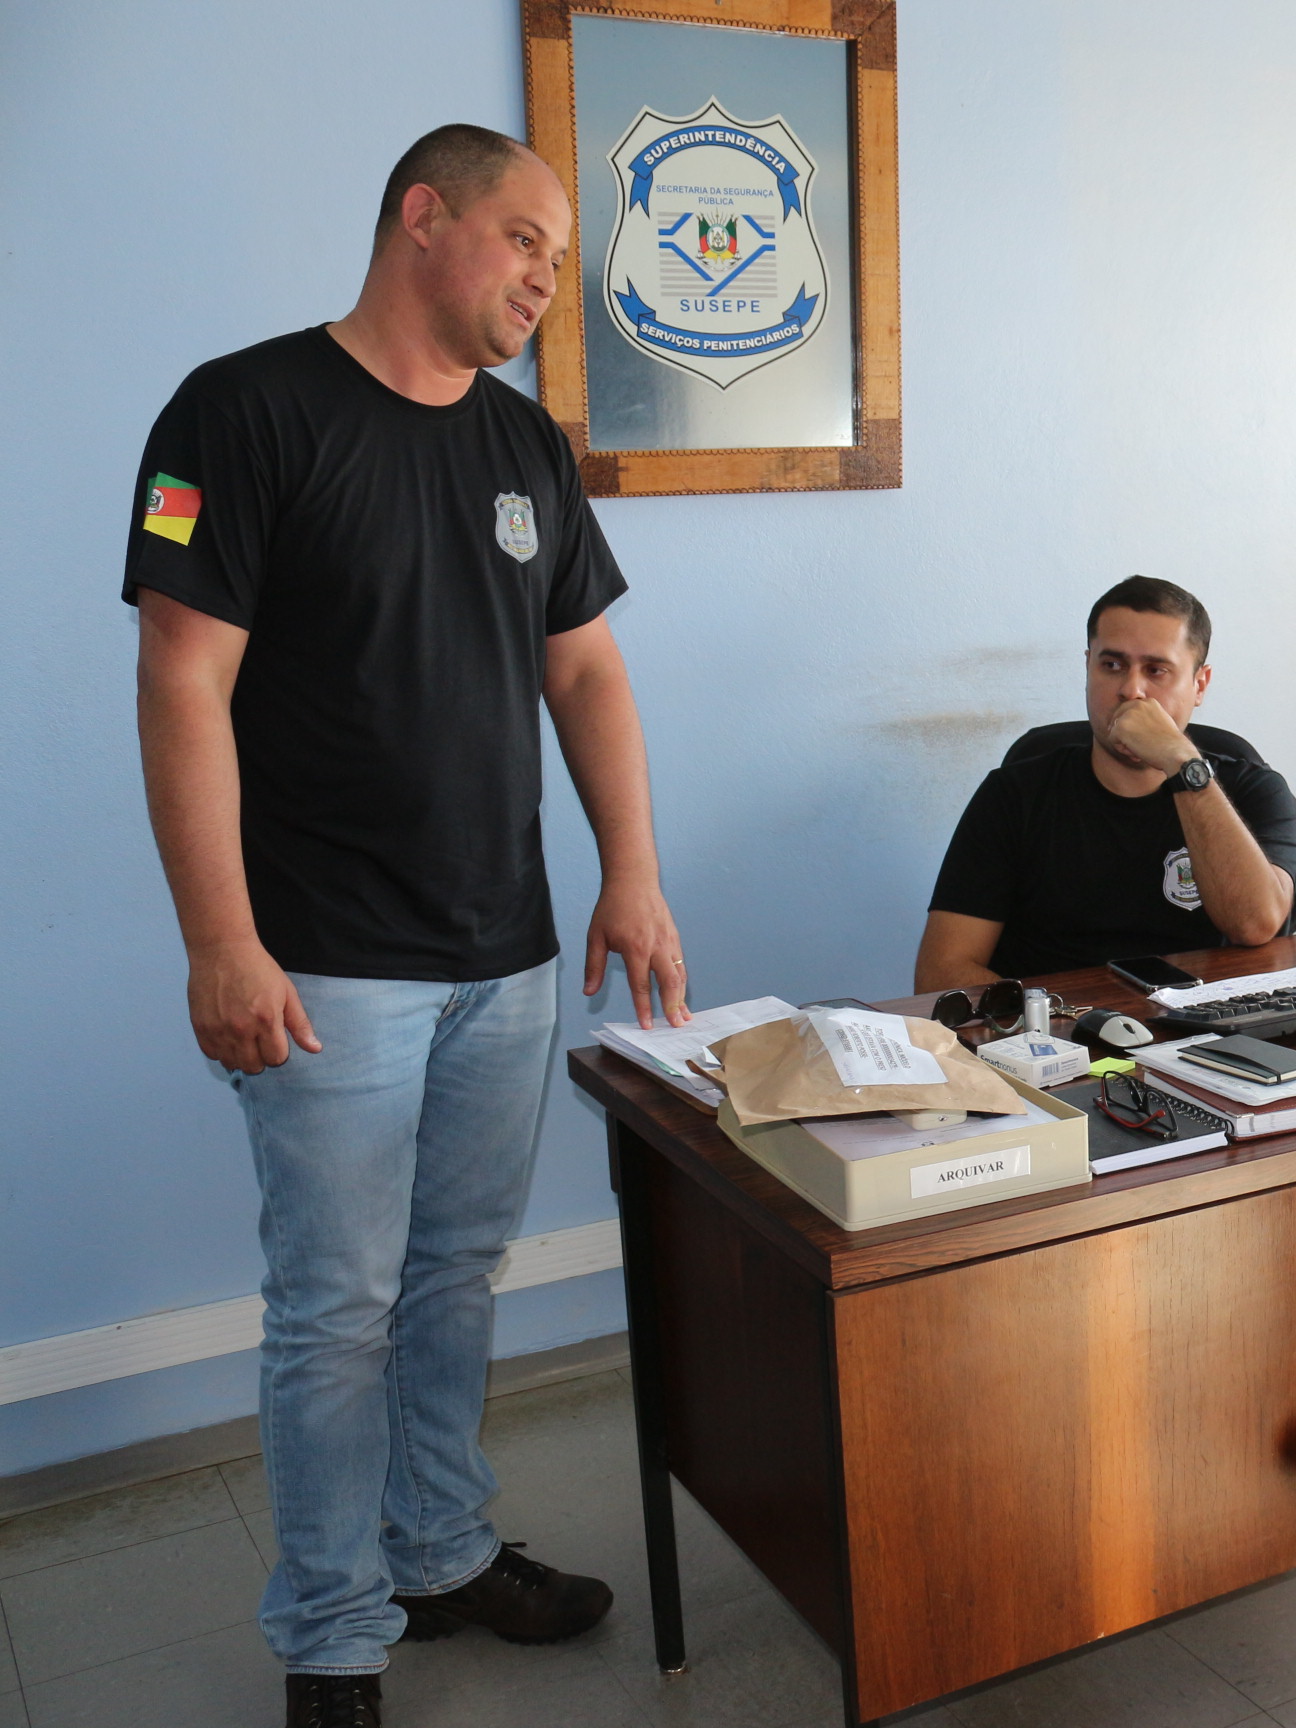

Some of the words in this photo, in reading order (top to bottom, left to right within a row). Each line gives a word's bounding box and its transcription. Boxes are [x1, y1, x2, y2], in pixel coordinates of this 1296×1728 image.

[643, 130, 786, 174] SUPERINTENDÊNCIA
[656, 185, 708, 194] SECRETARIA
[709, 186, 722, 195] DA
[723, 187, 774, 198] SEGURANÇA
[698, 195, 734, 205] PÚBLICA
[680, 299, 761, 313] SUSEPE
[640, 322, 700, 349] SERVIÇOS
[703, 323, 800, 350] PENITENCIÁRIOS
[937, 1161, 1004, 1183] ARQUIVAR
